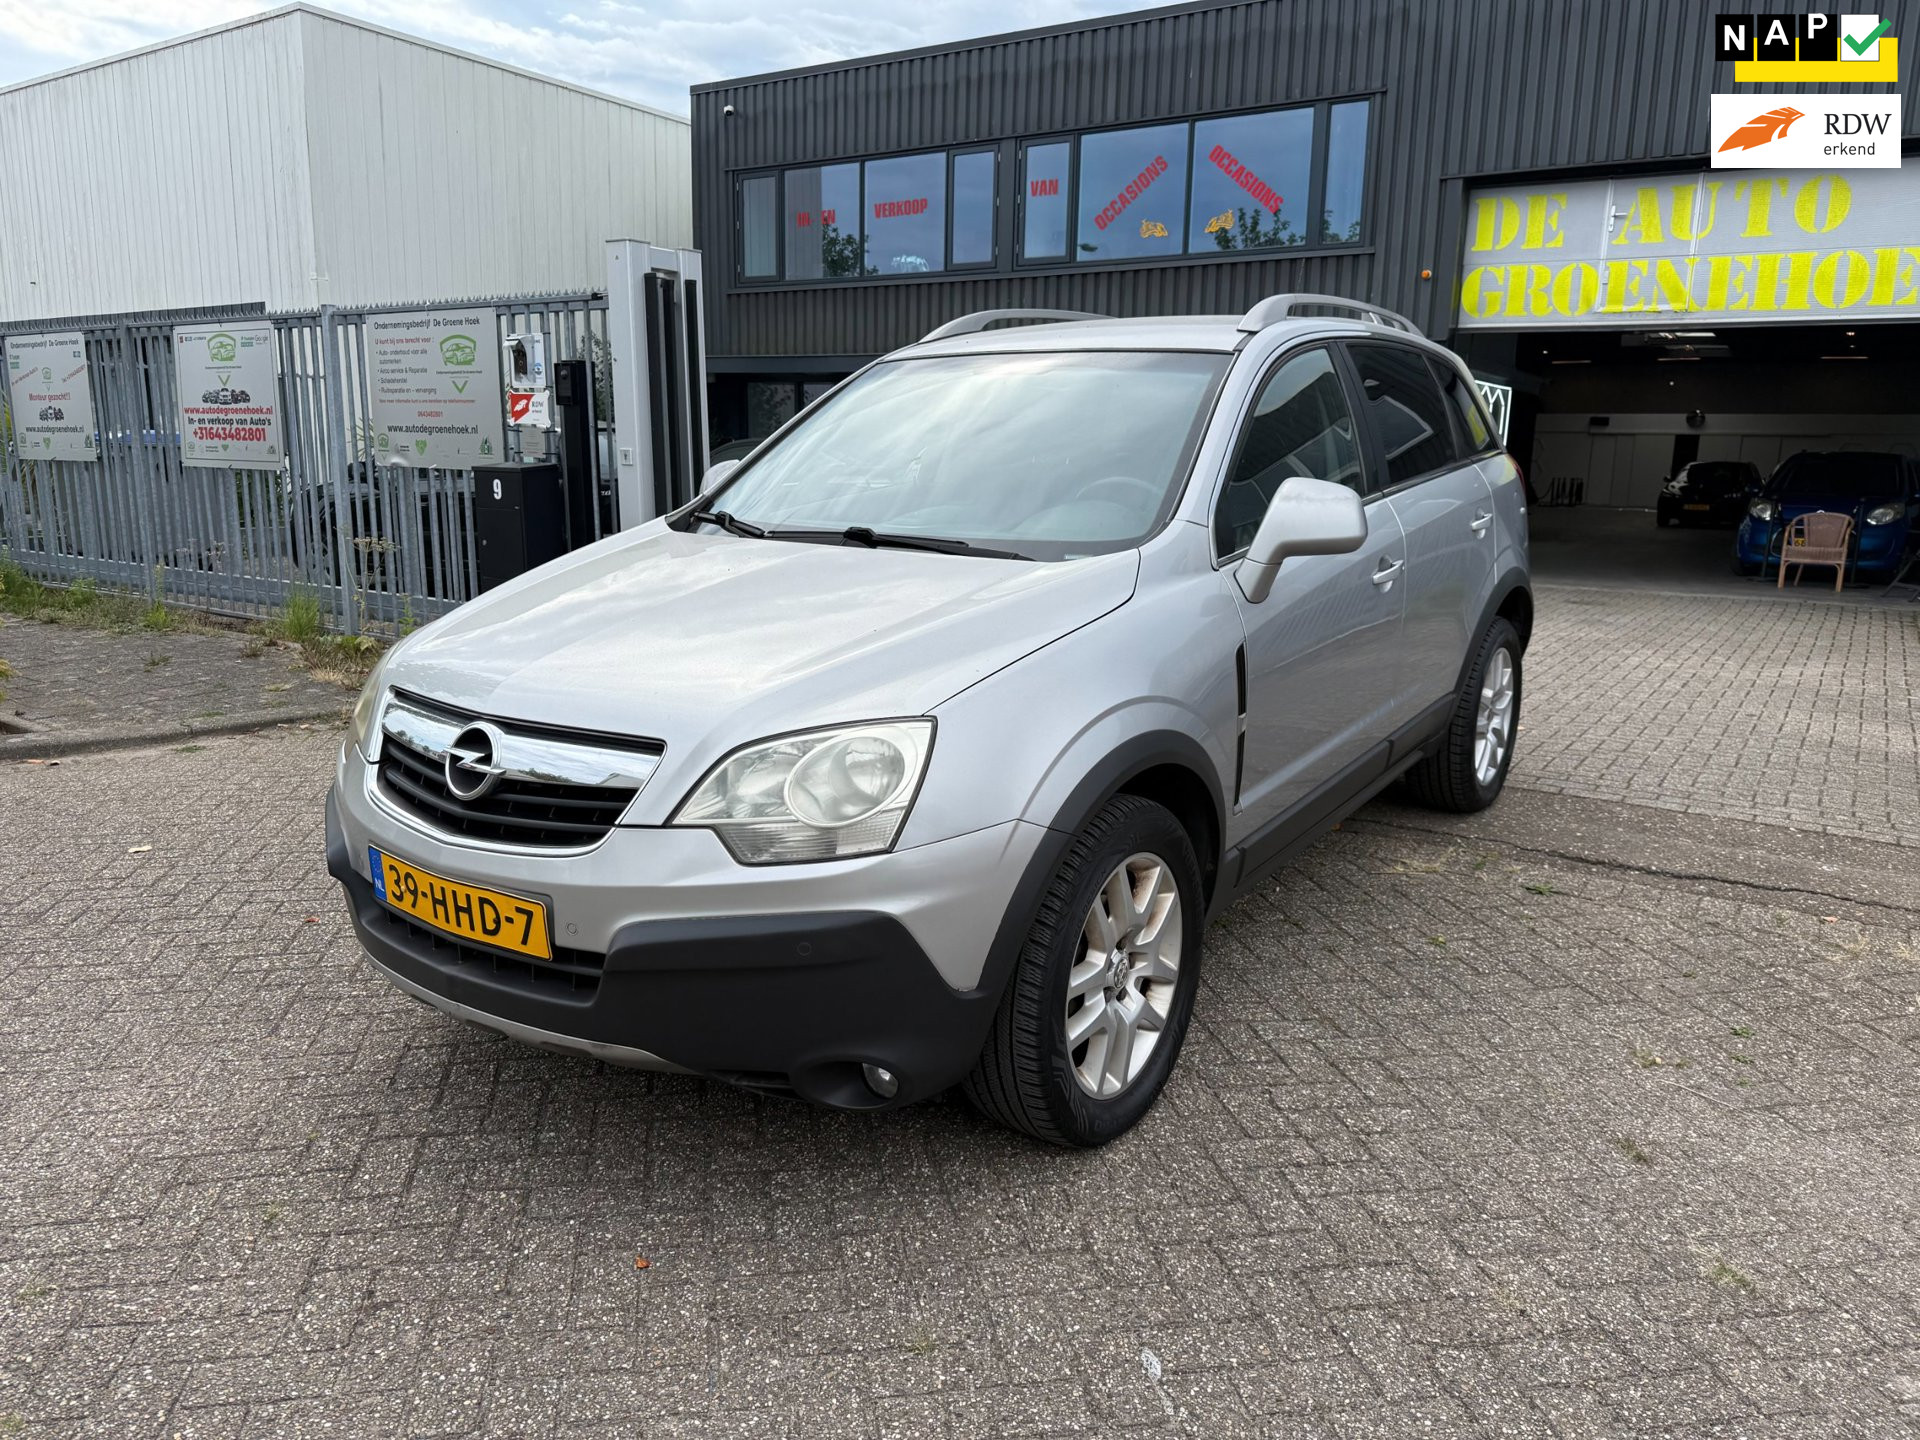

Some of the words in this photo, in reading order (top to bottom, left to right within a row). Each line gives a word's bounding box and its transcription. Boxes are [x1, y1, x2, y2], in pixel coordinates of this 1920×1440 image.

[1208, 144, 1285, 214] OCCASIONS
[874, 198, 928, 219] VERKOOP
[1030, 178, 1059, 197] VAN
[1094, 155, 1168, 231] OCCASIONS
[1471, 193, 1568, 252] DE
[1612, 174, 1853, 246] AUTO
[1461, 247, 1920, 318] GROENEHOE
[433, 318, 441, 327] De
[442, 317, 463, 327] Groene
[464, 316, 480, 325] Hoek
[184, 405, 273, 416] www.autodegroenehoek.nl
[207, 416, 234, 427] verkoop
[249, 416, 271, 426] Auto's
[193, 427, 267, 442] +31643482801
[387, 424, 478, 435] www.autodegroenehoek.nl
[493, 478, 502, 500] 9
[388, 864, 534, 946] 39-HHD-7
